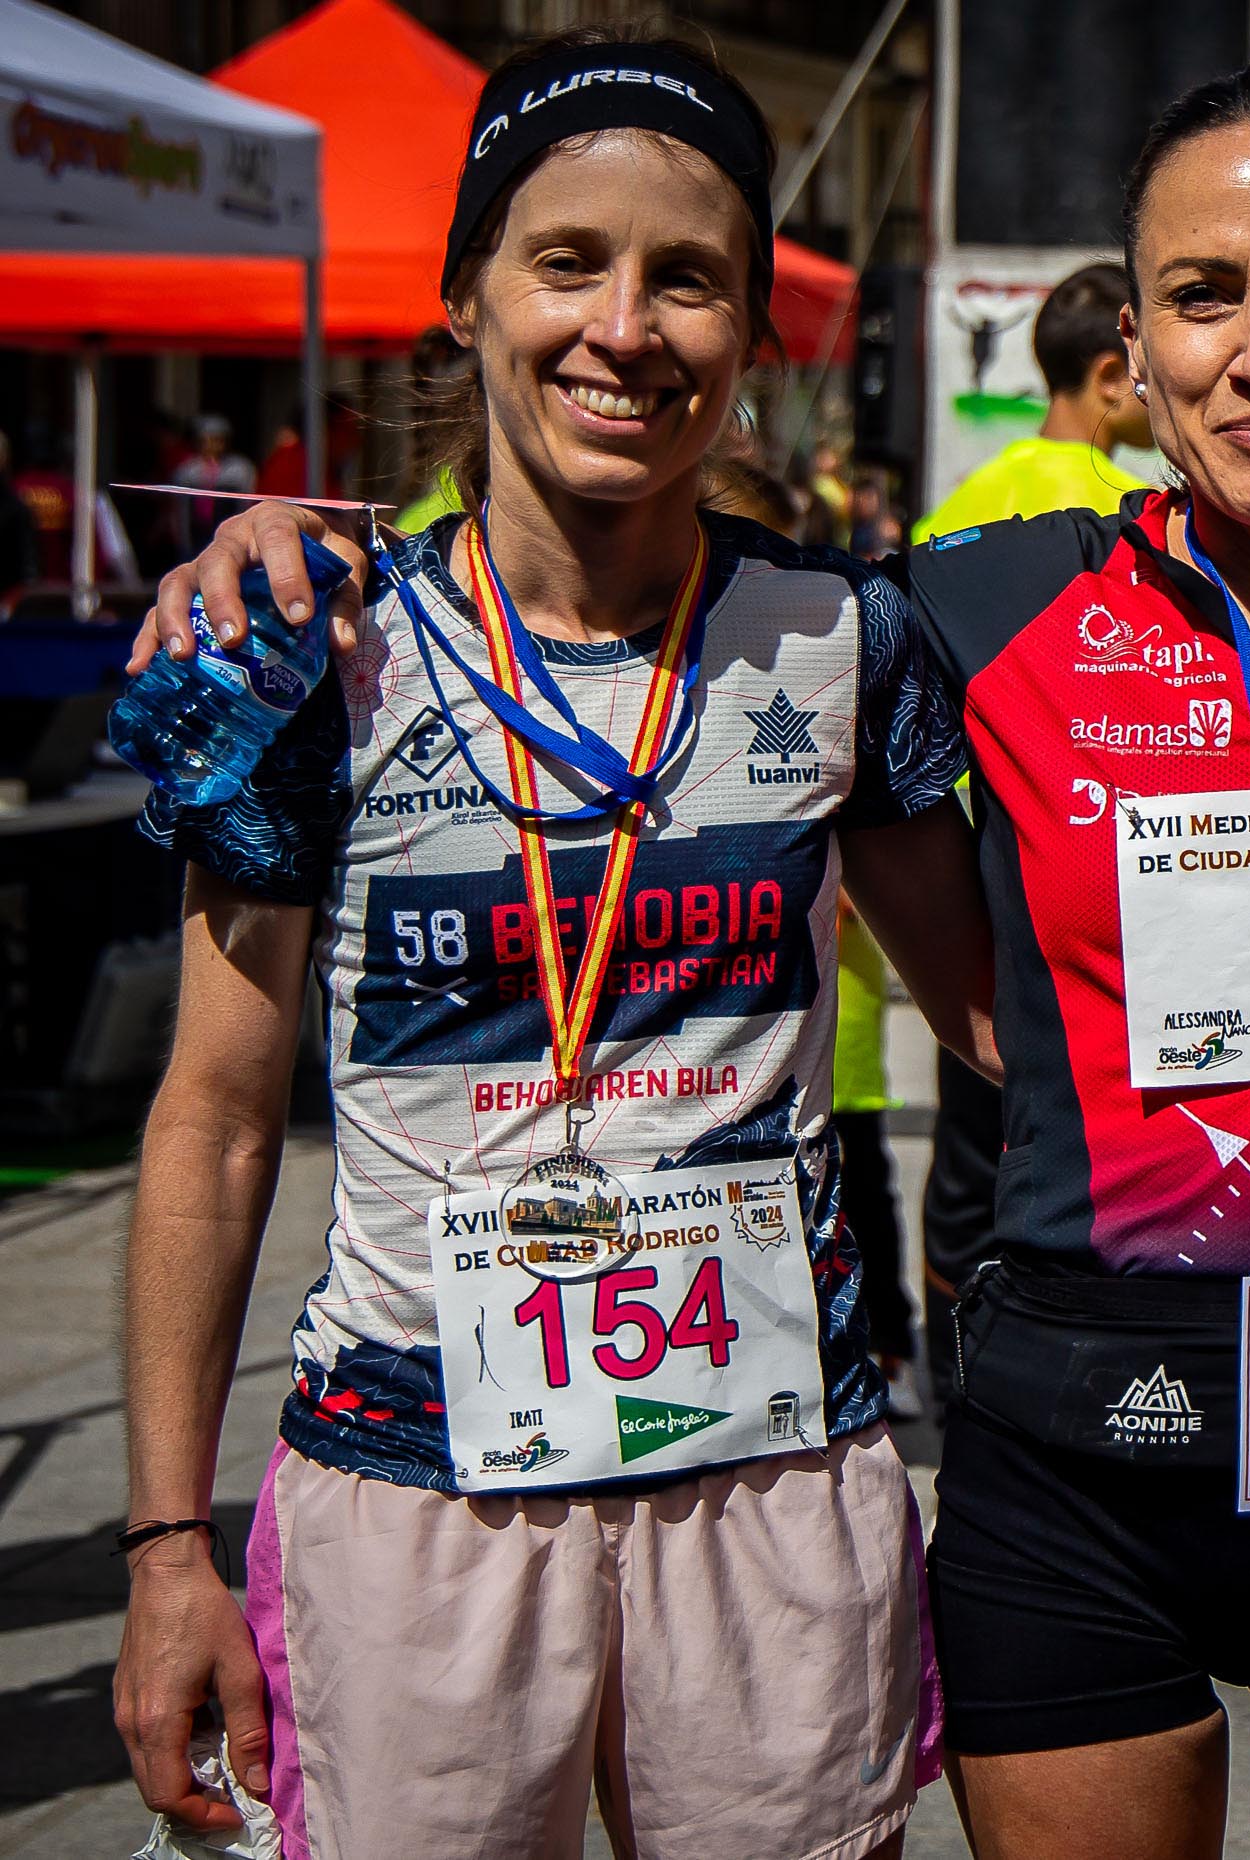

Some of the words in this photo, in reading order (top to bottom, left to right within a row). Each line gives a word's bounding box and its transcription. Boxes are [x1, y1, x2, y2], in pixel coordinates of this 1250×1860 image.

[520, 69, 713, 113] LURBEL
[1070, 715, 1188, 746] adamas
[747, 762, 820, 785] luanvi
[1128, 814, 1183, 841] XVII
[1138, 854, 1173, 874] DE
[393, 910, 470, 968] 58
[1164, 1009, 1243, 1030] ALESSANDRA
[677, 1065, 739, 1096] BILA
[440, 1210, 500, 1238] XVII
[750, 1204, 783, 1224] 2024
[455, 1250, 491, 1272] DE
[607, 1222, 721, 1255] RODRIGO
[514, 1255, 740, 1390] 154
[509, 1408, 544, 1429] IRATI
[620, 1419, 636, 1434] El
[635, 1415, 666, 1432] Corte
[667, 1410, 710, 1434] Inglés
[1104, 1412, 1203, 1432] AONIJIE
[1113, 1432, 1191, 1444] RUNNING
